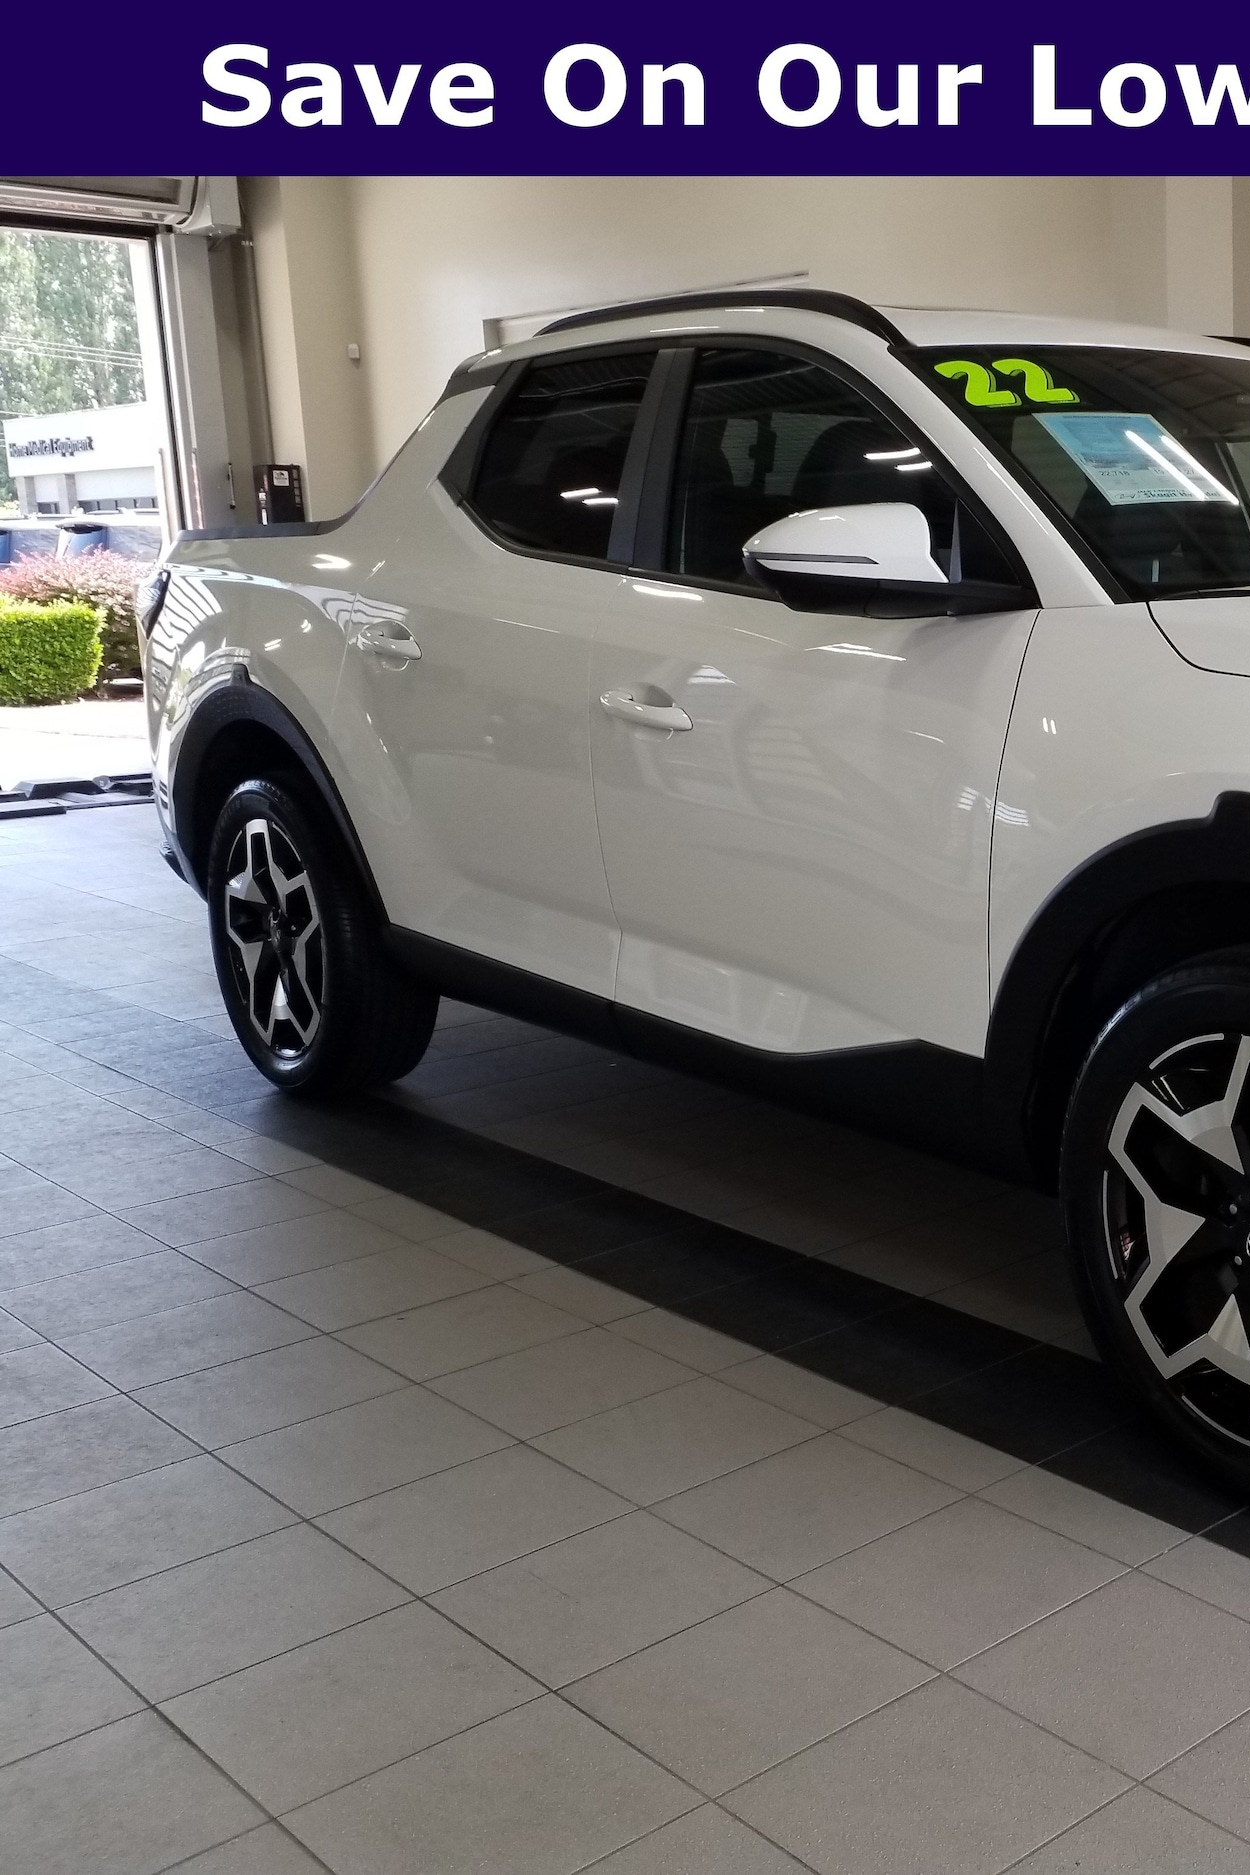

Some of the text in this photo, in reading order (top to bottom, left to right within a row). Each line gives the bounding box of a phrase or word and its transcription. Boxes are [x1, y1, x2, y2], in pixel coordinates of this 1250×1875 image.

[933, 358, 1080, 408] 22
[9, 436, 94, 457] Home Medical Equipment
